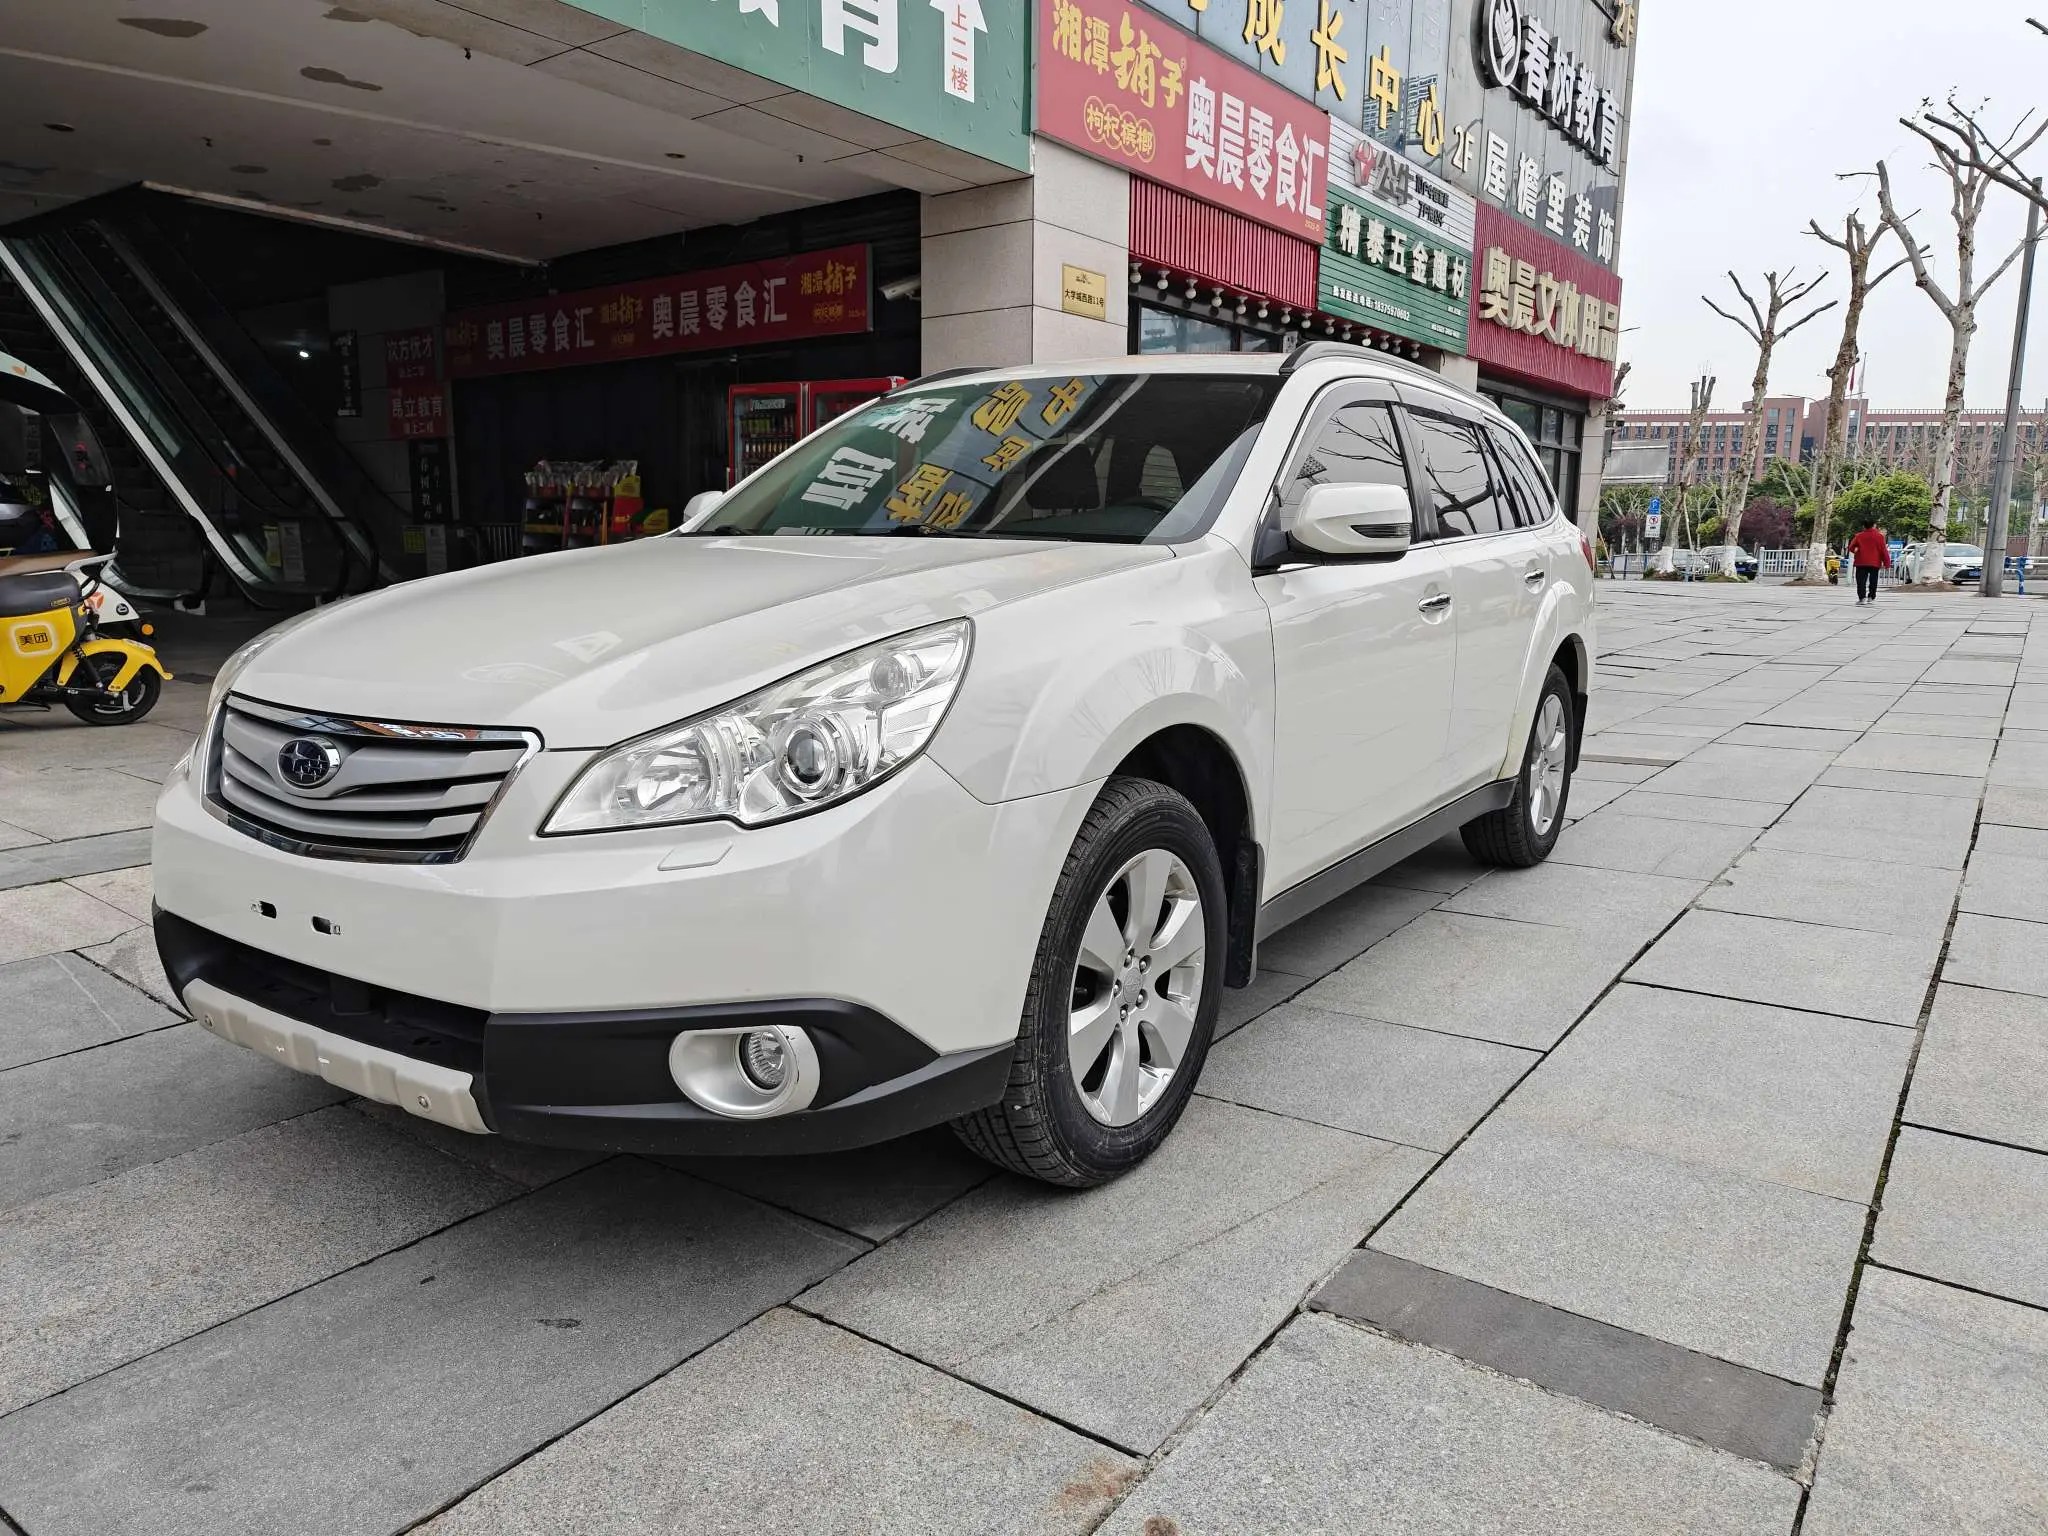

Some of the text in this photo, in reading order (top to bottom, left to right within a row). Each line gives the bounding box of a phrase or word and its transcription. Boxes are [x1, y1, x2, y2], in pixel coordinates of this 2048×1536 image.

[951, 4, 969, 94] 上二楼
[1052, 0, 1184, 108] 湘潭铺子
[1188, 0, 1444, 157] 成长中心
[1523, 14, 1620, 166] 春树教育
[1086, 100, 1154, 159] 枸杞槟榔
[1185, 75, 1326, 221] 奥晨零食汇
[1451, 124, 1615, 265] 2F 屋檐里装饰
[486, 306, 595, 361] 奥晨零食汇
[652, 277, 788, 339] 奥晨零食汇
[1480, 245, 1618, 362] 奥晨文体用品
[19, 632, 49, 646] 美团
